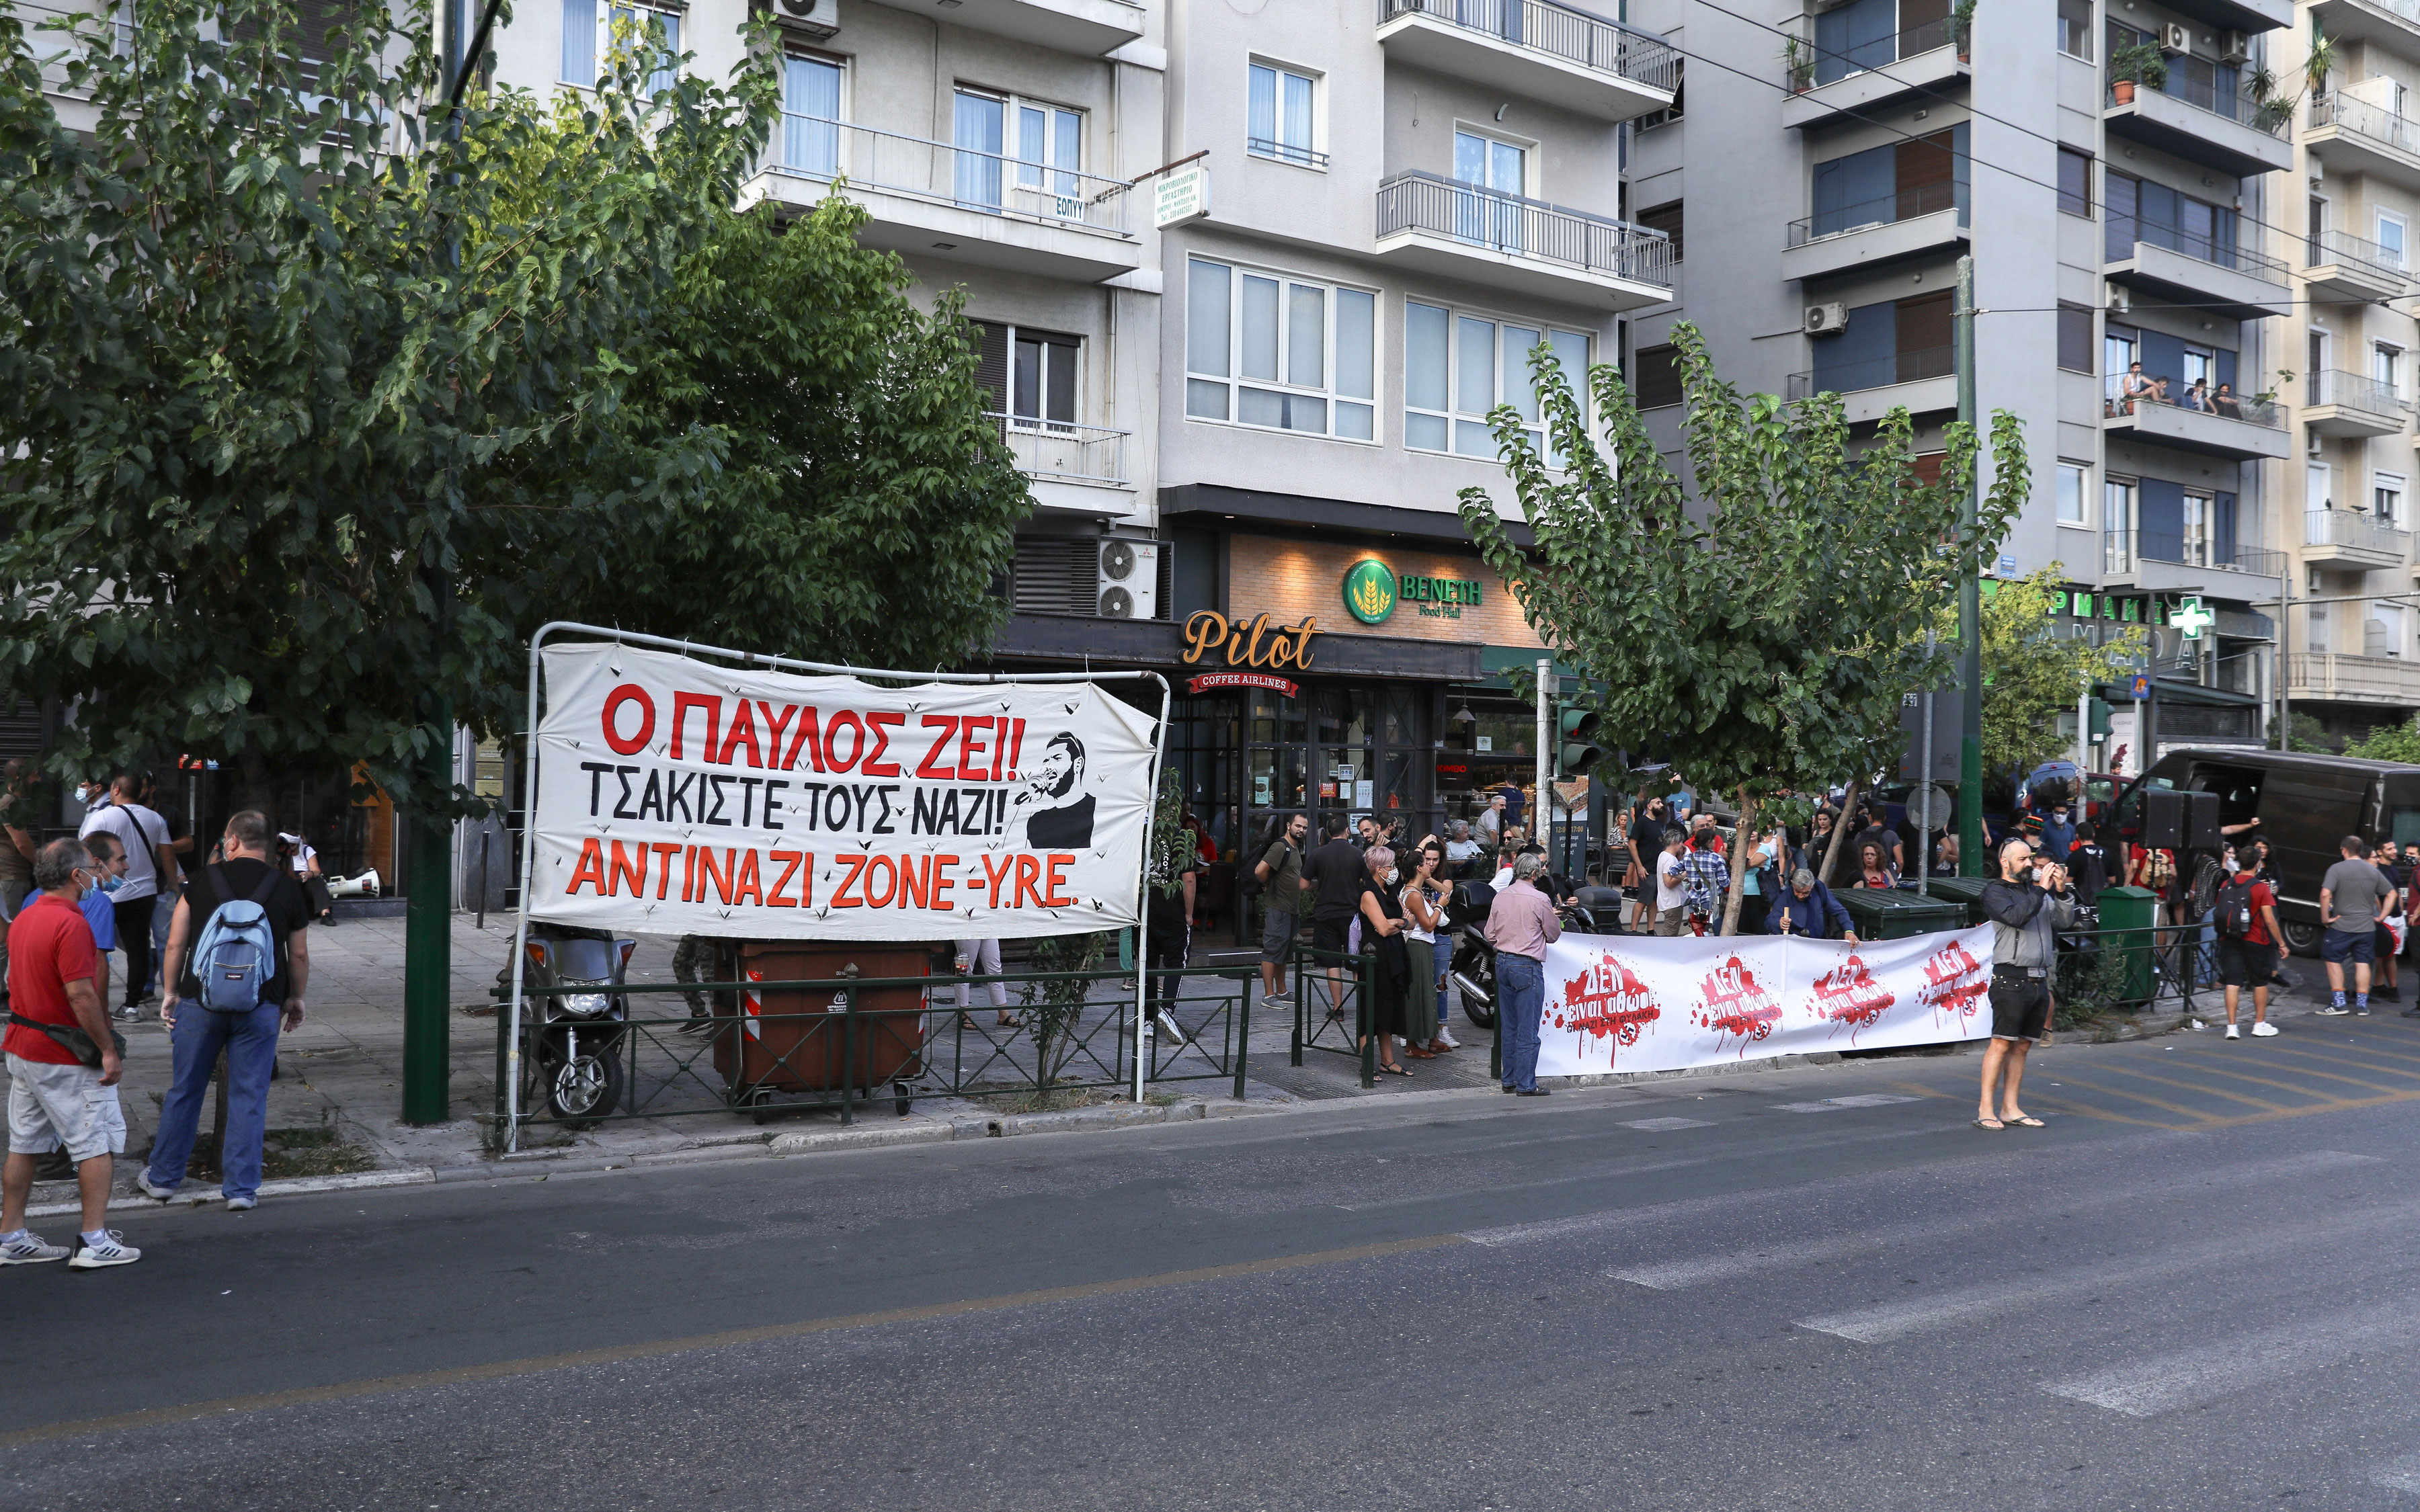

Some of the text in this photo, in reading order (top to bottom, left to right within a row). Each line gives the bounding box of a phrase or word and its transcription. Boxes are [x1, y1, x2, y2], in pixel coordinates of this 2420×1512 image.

[1158, 171, 1198, 194] ΜΙΚΡΟΒΙΟΛΟΓΙΚΟ
[1162, 184, 1193, 203] ΕΡΓΑΣΤΗΡΙΟ
[1057, 196, 1083, 219] ΕΟΠΥΥ
[1419, 604, 1461, 618] Food Hall
[1181, 610, 1326, 670] Pilot
[1203, 675, 1287, 689] COFFEE AIRLINES
[601, 683, 1026, 782] Ο ΠΑΥΛΟΣ ΖΕΙ!!
[581, 761, 1009, 836] ΤΣΑΚΙΣΤΕ ΤΟΥΣ ΝΑΖΙ!
[830, 853, 960, 911] ZONE
[1584, 964, 1624, 996] ΔΕΝ
[1711, 966, 1744, 997] ΔΕΝ
[1568, 987, 1654, 1022] είναι αθώοι
[1710, 989, 1774, 1021] είναι αθώοι
[1754, 1010, 1778, 1021] ΦΥΛΑΚΗ
[1579, 1020, 1597, 1032] ΝΑΖΙ
[1600, 1017, 1616, 1027] ΣΤΗ
[1619, 1009, 1654, 1023] ΦΥΛΑΚΗ
